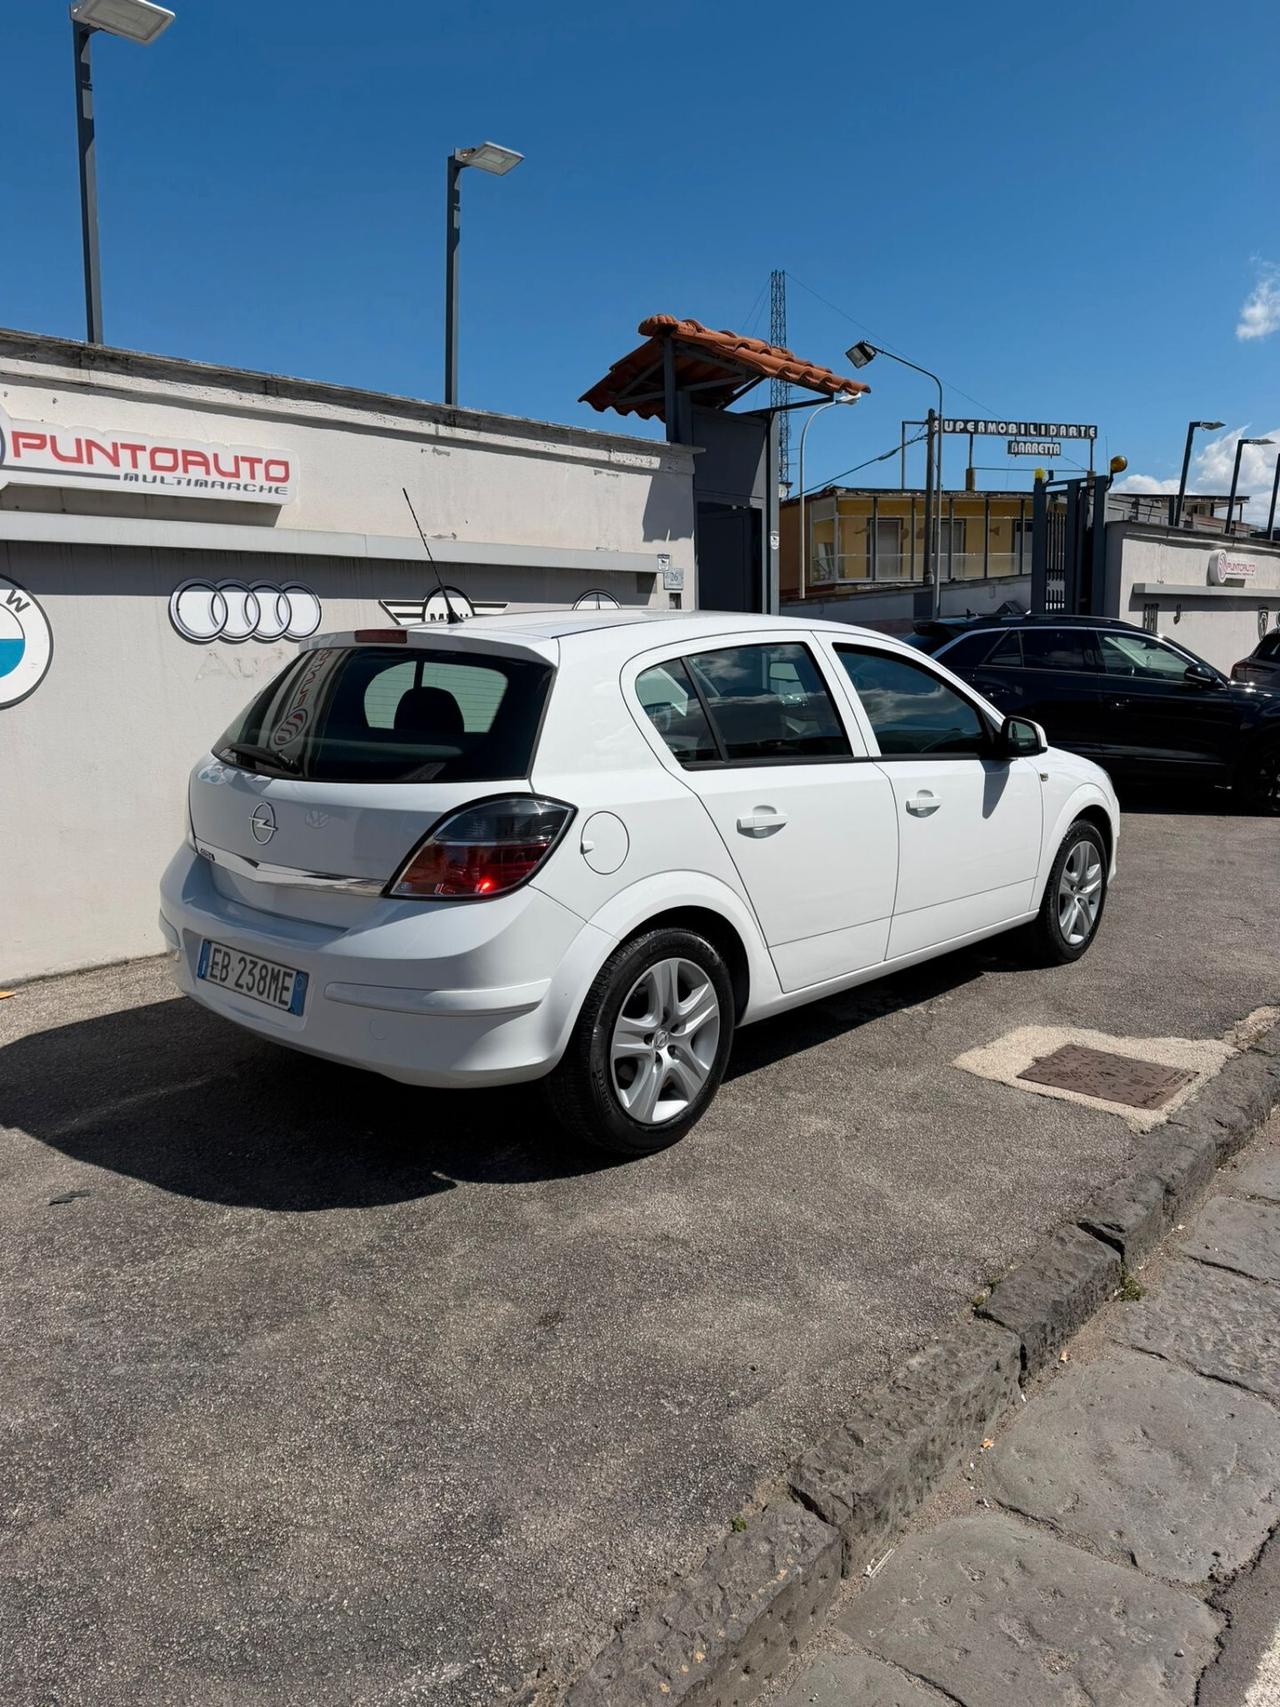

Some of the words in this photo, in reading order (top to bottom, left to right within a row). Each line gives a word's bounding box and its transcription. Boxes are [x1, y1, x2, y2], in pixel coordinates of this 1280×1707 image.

[11, 430, 290, 484] PUNTOAUTO
[1011, 441, 1061, 455] BARRETTA
[123, 472, 289, 496] MULTIMARCHE
[209, 947, 231, 983] EB
[234, 956, 294, 1006] 238ME
